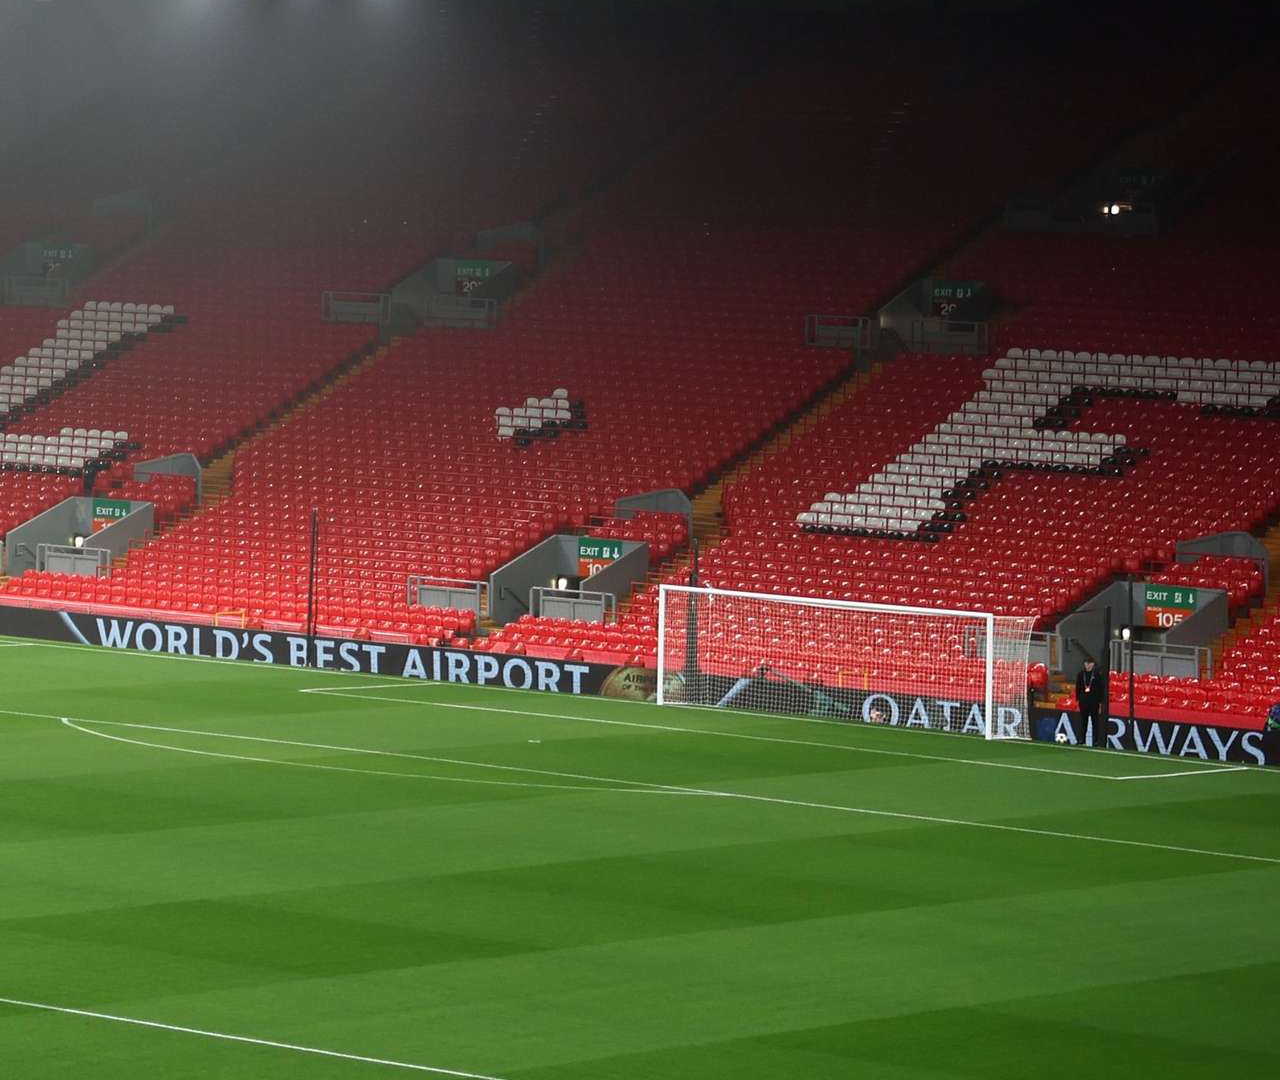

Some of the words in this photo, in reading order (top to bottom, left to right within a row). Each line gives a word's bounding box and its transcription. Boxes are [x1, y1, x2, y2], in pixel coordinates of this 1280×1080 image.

[96, 507, 114, 516] EXIT
[580, 546, 600, 557] EXIT
[1146, 591, 1169, 601] EXIT
[1155, 612, 1184, 628] 105
[96, 617, 274, 665] WORLD'S
[287, 636, 386, 673] BEST
[402, 648, 590, 695] AIRPORT
[862, 694, 1023, 738] QATAR
[1054, 712, 1266, 766] AIRWAYS
